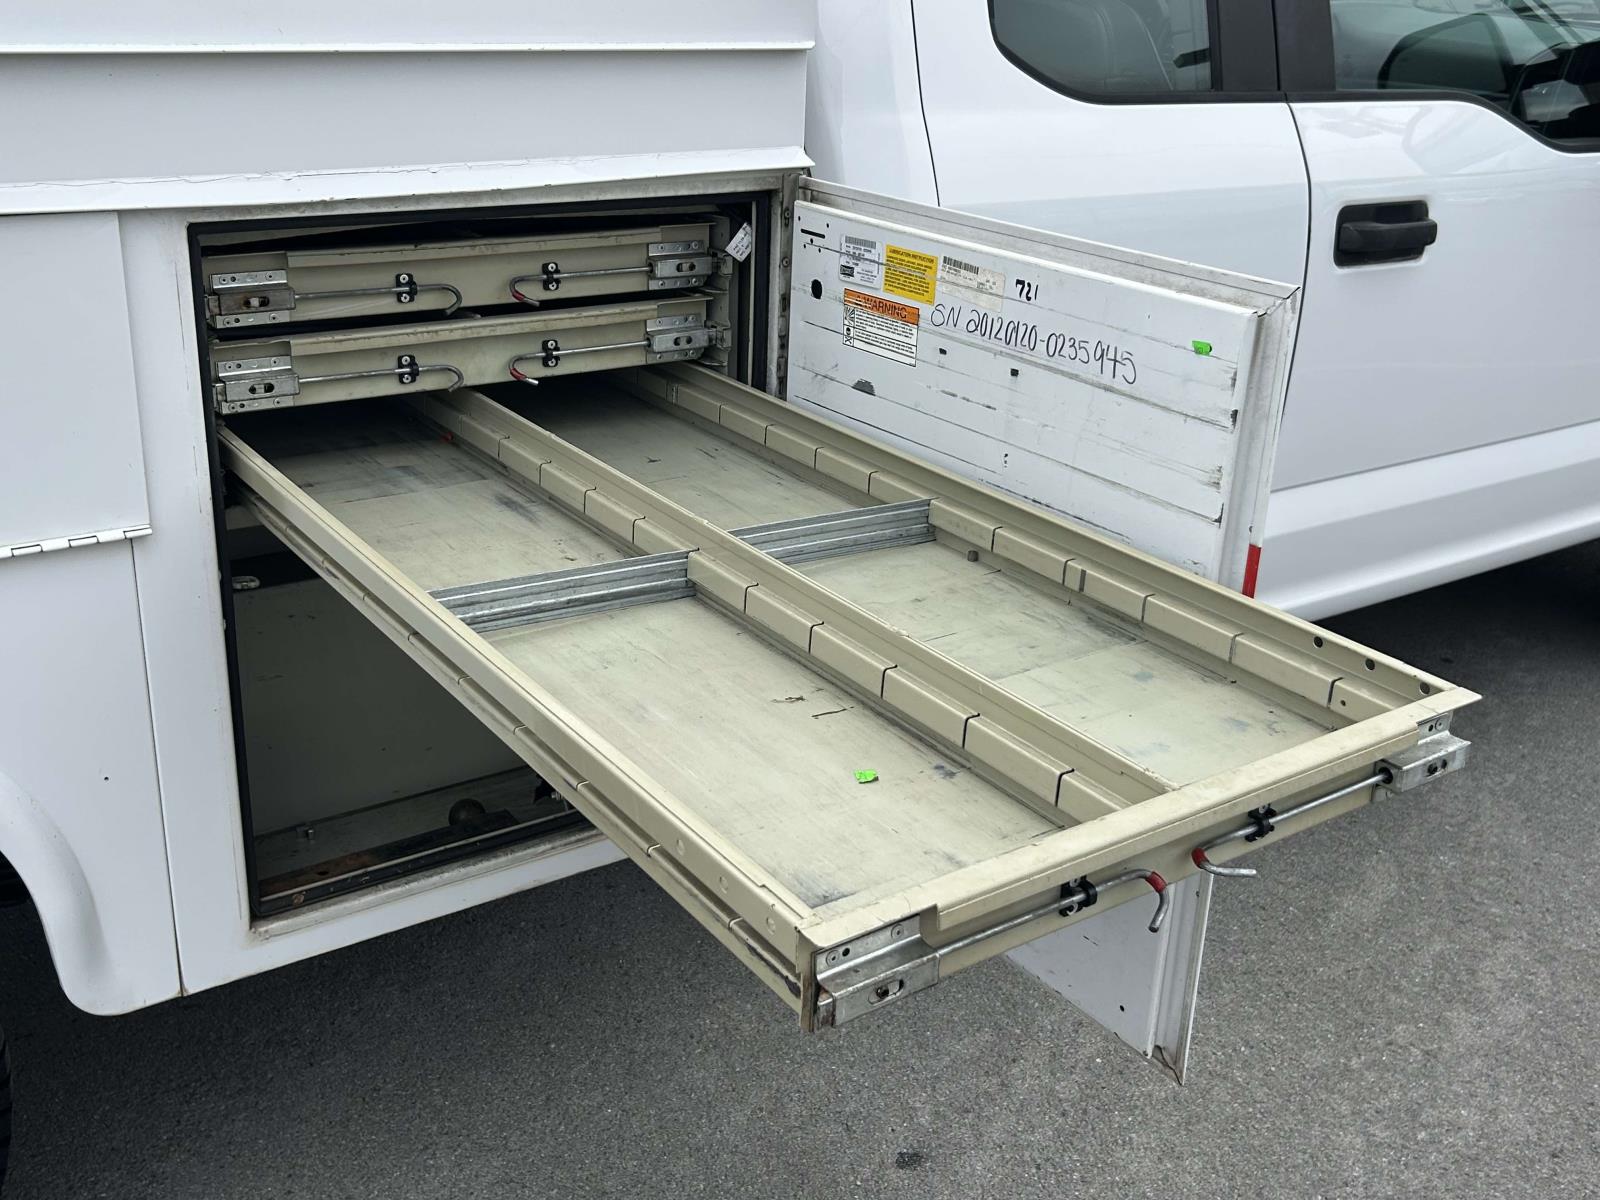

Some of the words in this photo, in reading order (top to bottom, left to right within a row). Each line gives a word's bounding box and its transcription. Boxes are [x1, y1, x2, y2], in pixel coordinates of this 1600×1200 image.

[1015, 278, 1039, 302] 721
[863, 296, 907, 319] WARNING
[930, 303, 962, 328] SN
